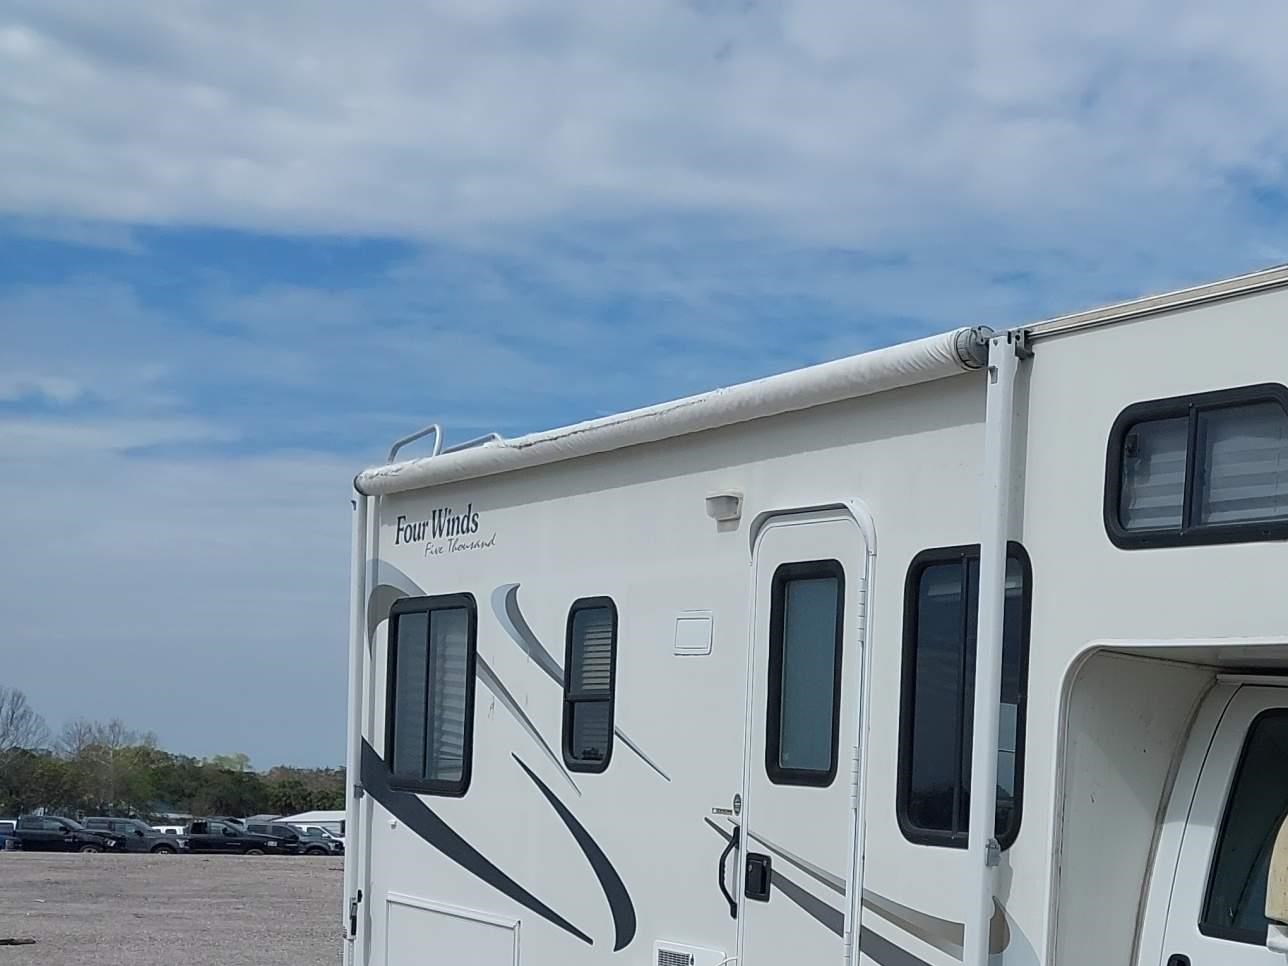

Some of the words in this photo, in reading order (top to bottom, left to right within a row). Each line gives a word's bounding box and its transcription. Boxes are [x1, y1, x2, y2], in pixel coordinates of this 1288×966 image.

[395, 515, 429, 545] Four
[432, 503, 480, 539] Winds
[424, 542, 445, 558] Five
[447, 533, 497, 554] Thousand
